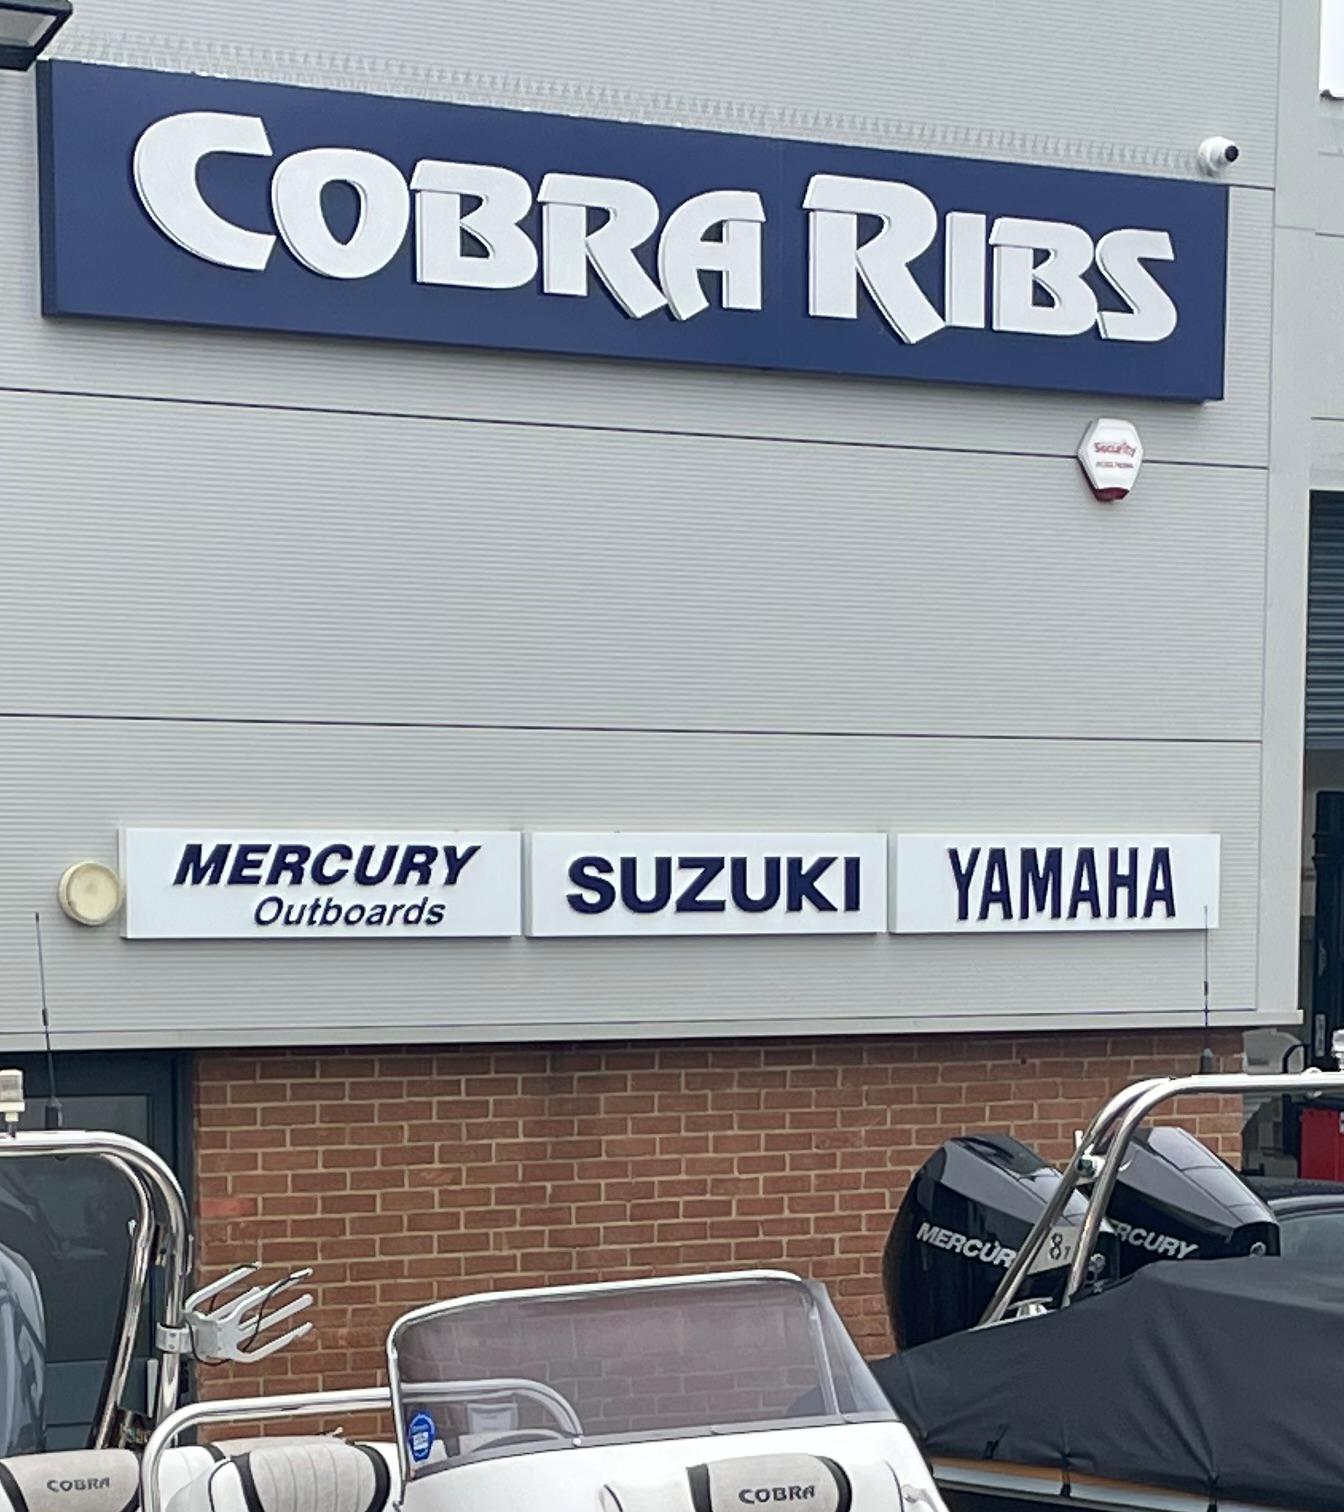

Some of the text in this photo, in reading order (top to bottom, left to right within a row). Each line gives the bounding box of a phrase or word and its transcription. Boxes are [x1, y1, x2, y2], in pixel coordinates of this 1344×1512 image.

[133, 111, 1178, 344] COBRA RIBS
[172, 844, 481, 886] MERCURY
[565, 855, 861, 915] SUZUKI
[946, 847, 1176, 921] YAMAHA
[254, 896, 446, 926] Outboards
[916, 1222, 1017, 1269] MERCUR
[46, 1477, 111, 1492] COBRA
[738, 1485, 815, 1504] COBRA
